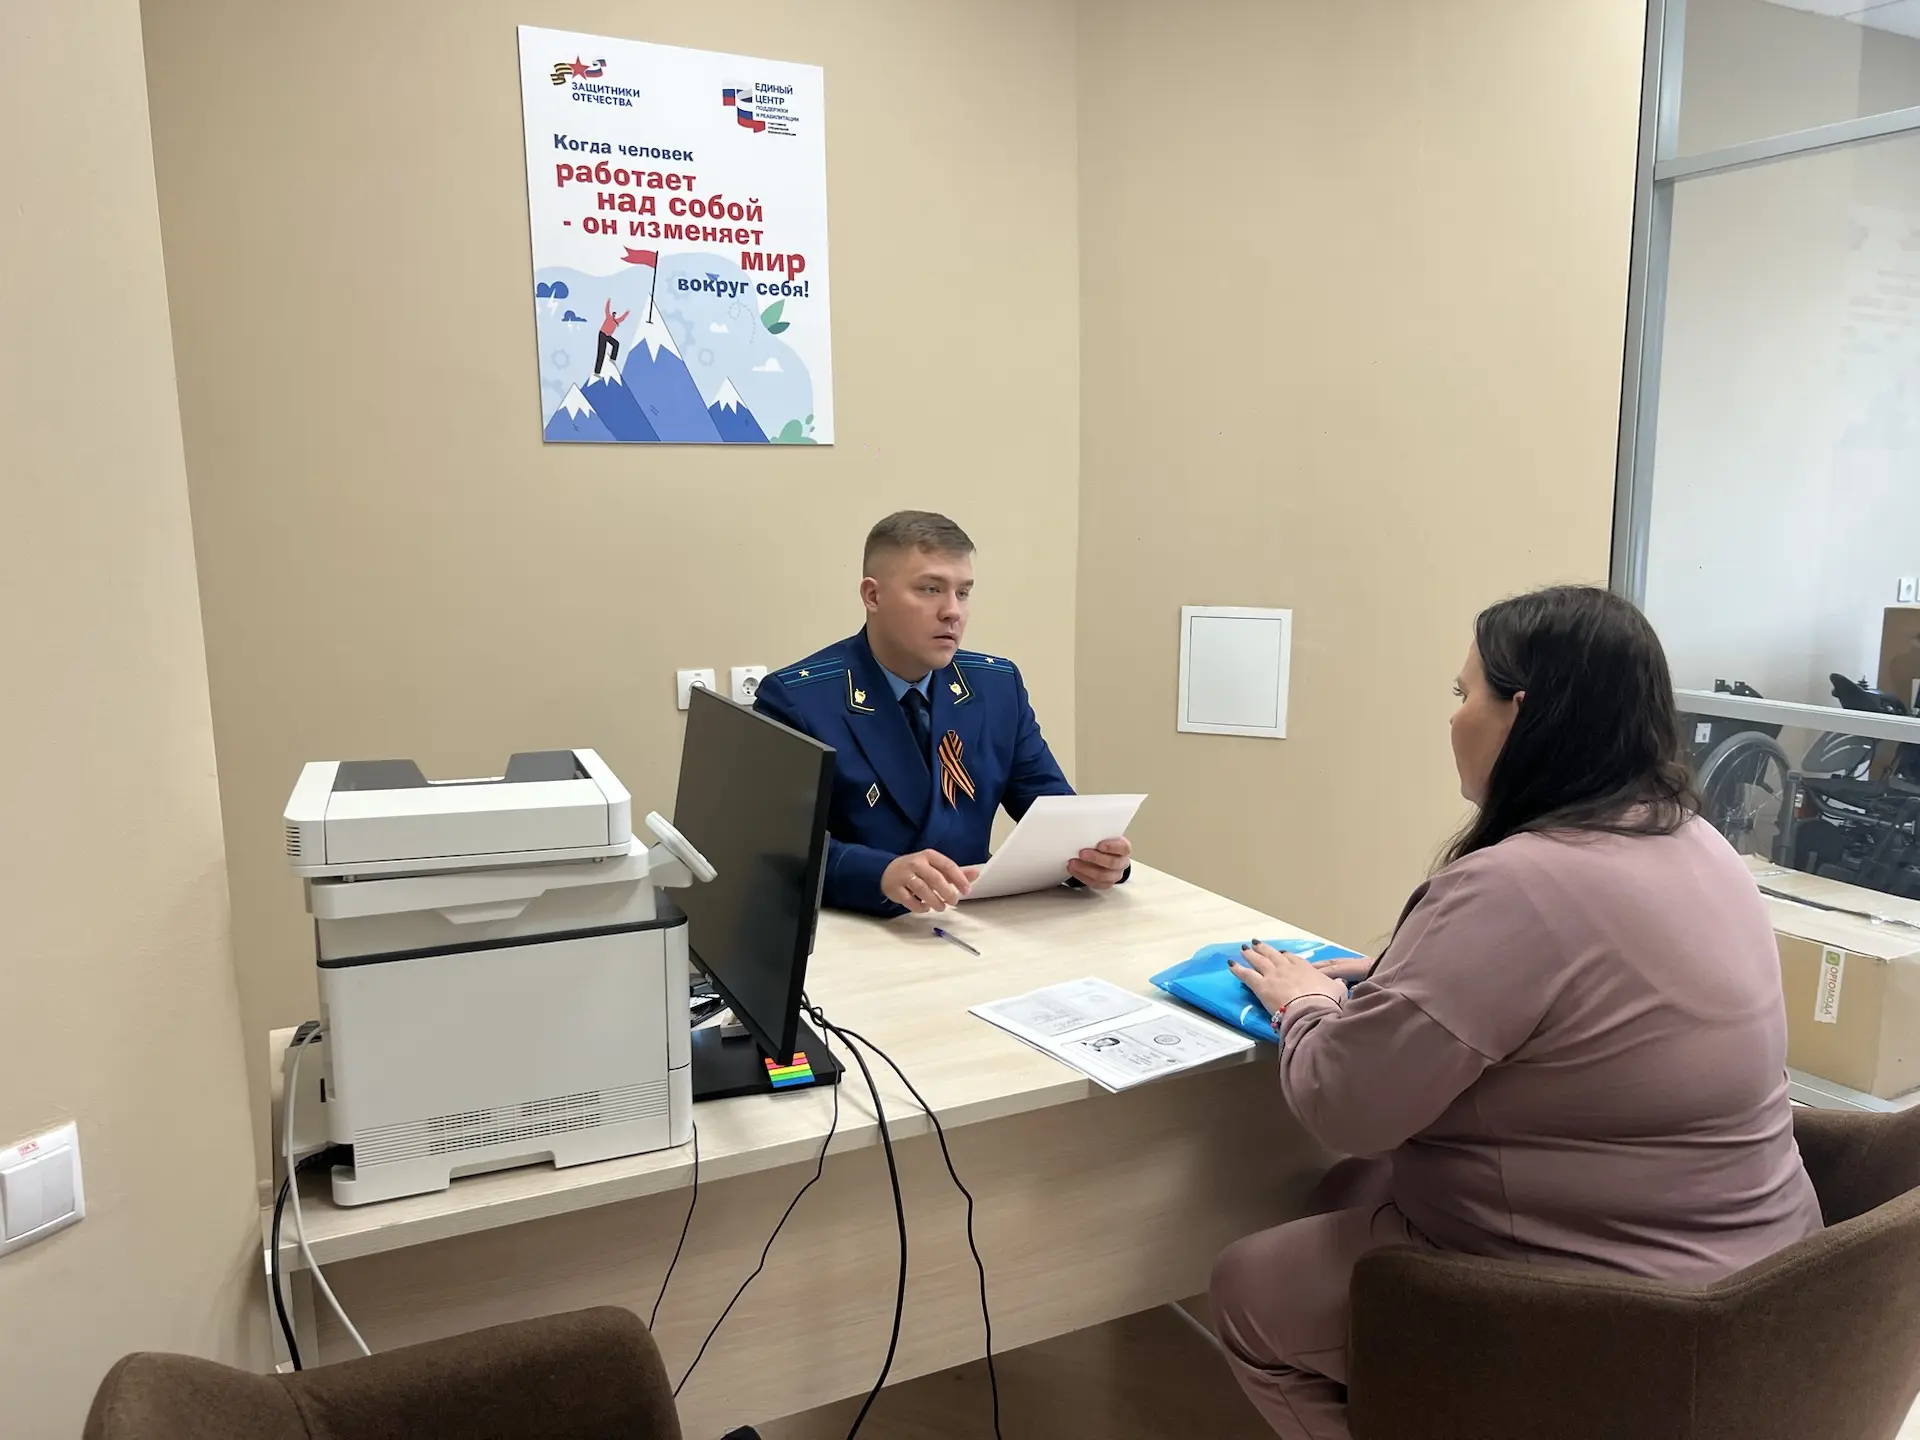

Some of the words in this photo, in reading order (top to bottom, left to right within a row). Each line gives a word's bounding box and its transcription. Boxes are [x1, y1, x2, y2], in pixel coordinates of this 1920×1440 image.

[571, 82, 640, 98] ЗАЩИТНИКИ
[572, 92, 633, 107] ОТЕЧЕСТВА
[755, 82, 793, 95] ЕДИНЫЙ
[755, 95, 785, 105] ЦЕНТР
[553, 133, 612, 155] Когда
[618, 143, 694, 162] человек
[556, 161, 696, 191] работает
[597, 192, 656, 215] над
[669, 194, 763, 222] собой
[583, 217, 617, 235] он
[629, 221, 763, 245] изменяет
[741, 251, 806, 281] мир
[677, 278, 749, 298] вокруг
[756, 280, 809, 298] себя!
[1824, 966, 1839, 1015] ОРТОМОДА
